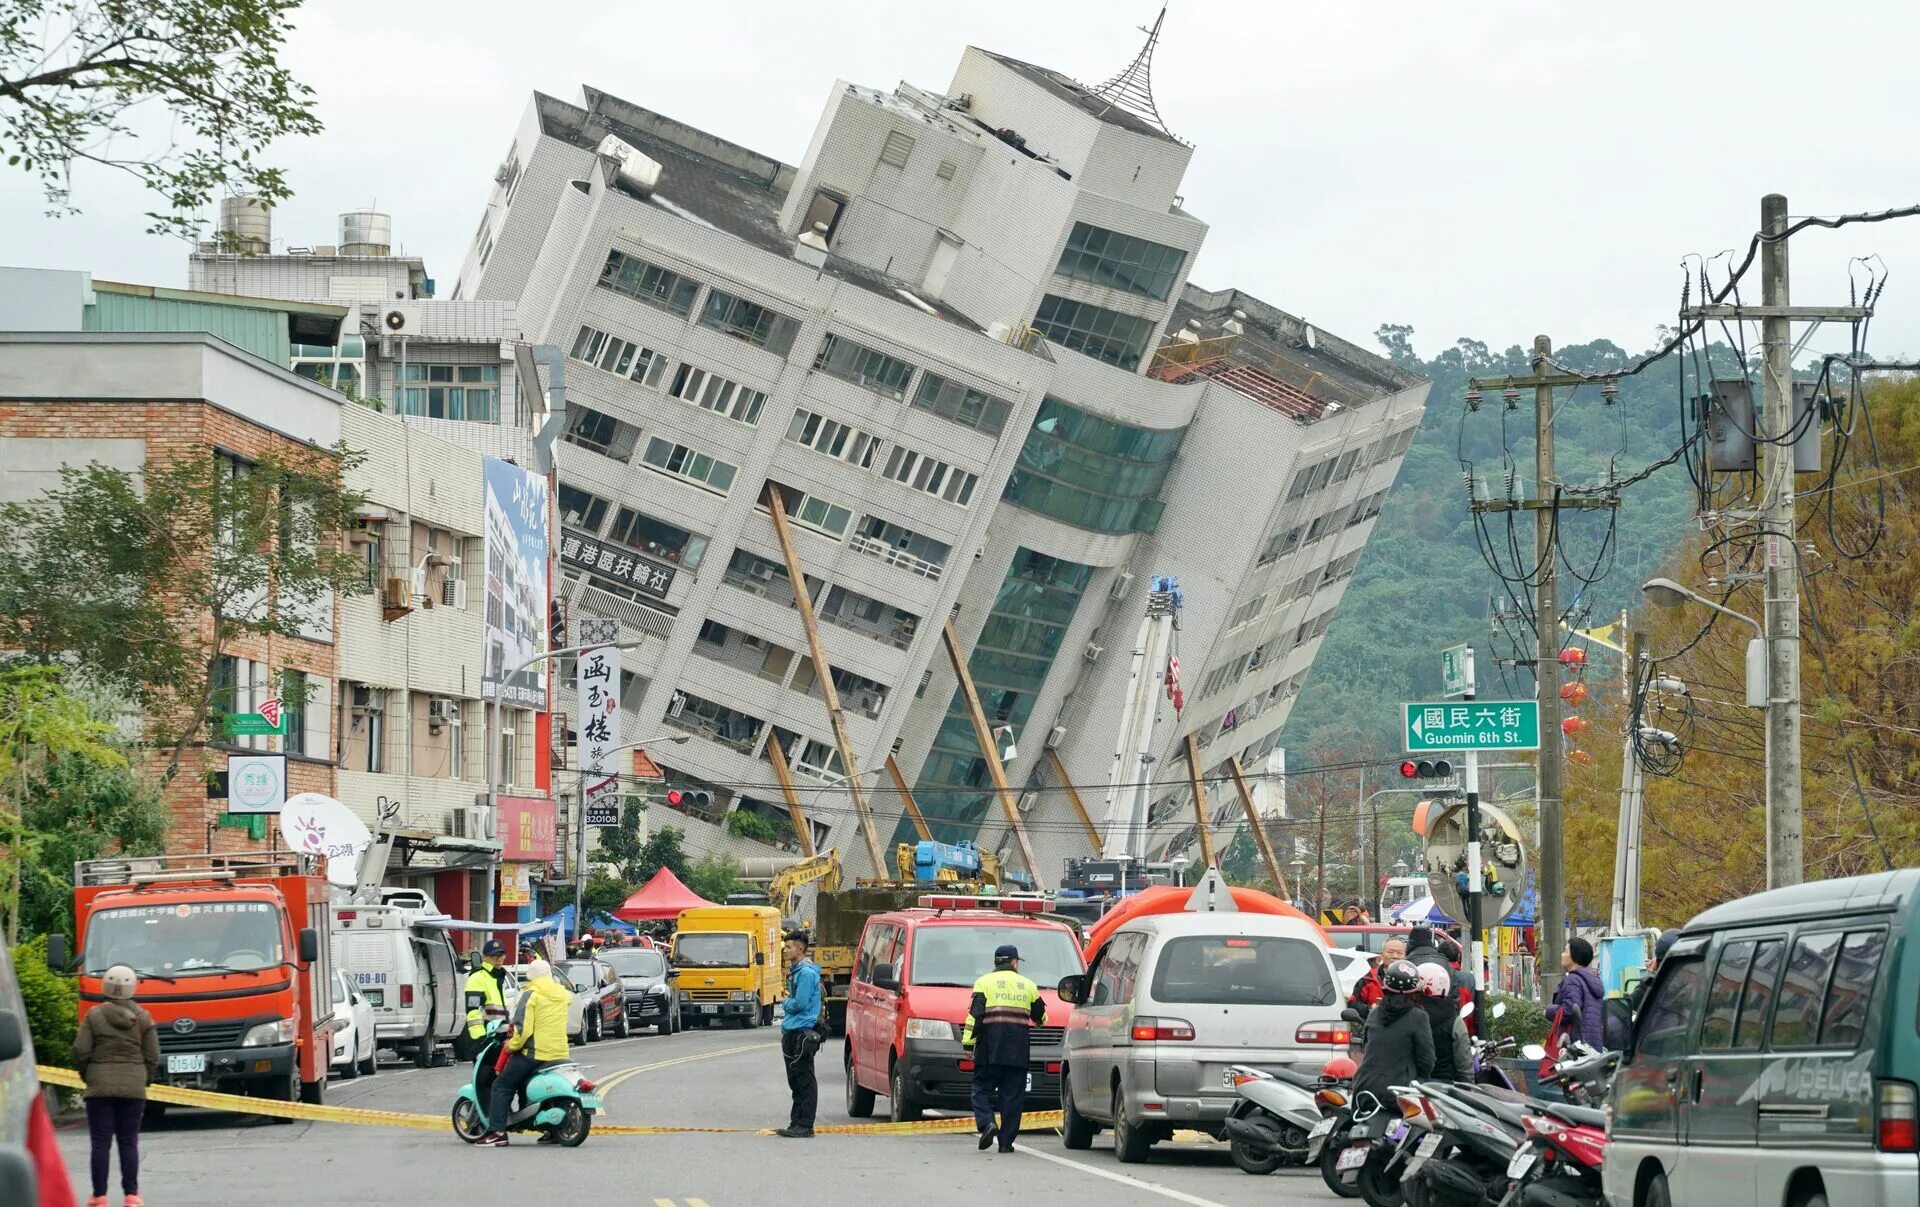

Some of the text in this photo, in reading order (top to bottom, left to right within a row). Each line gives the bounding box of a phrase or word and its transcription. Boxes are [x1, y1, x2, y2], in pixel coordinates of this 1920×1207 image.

[561, 536, 668, 592] 蓮港區扶輪社
[1424, 707, 1521, 730] 國民六街
[1425, 730, 1522, 745] Guomin 6th St.
[328, 843, 355, 857] 公視
[995, 992, 1029, 1003] POLICE
[1799, 1067, 1874, 1100] DELICA
